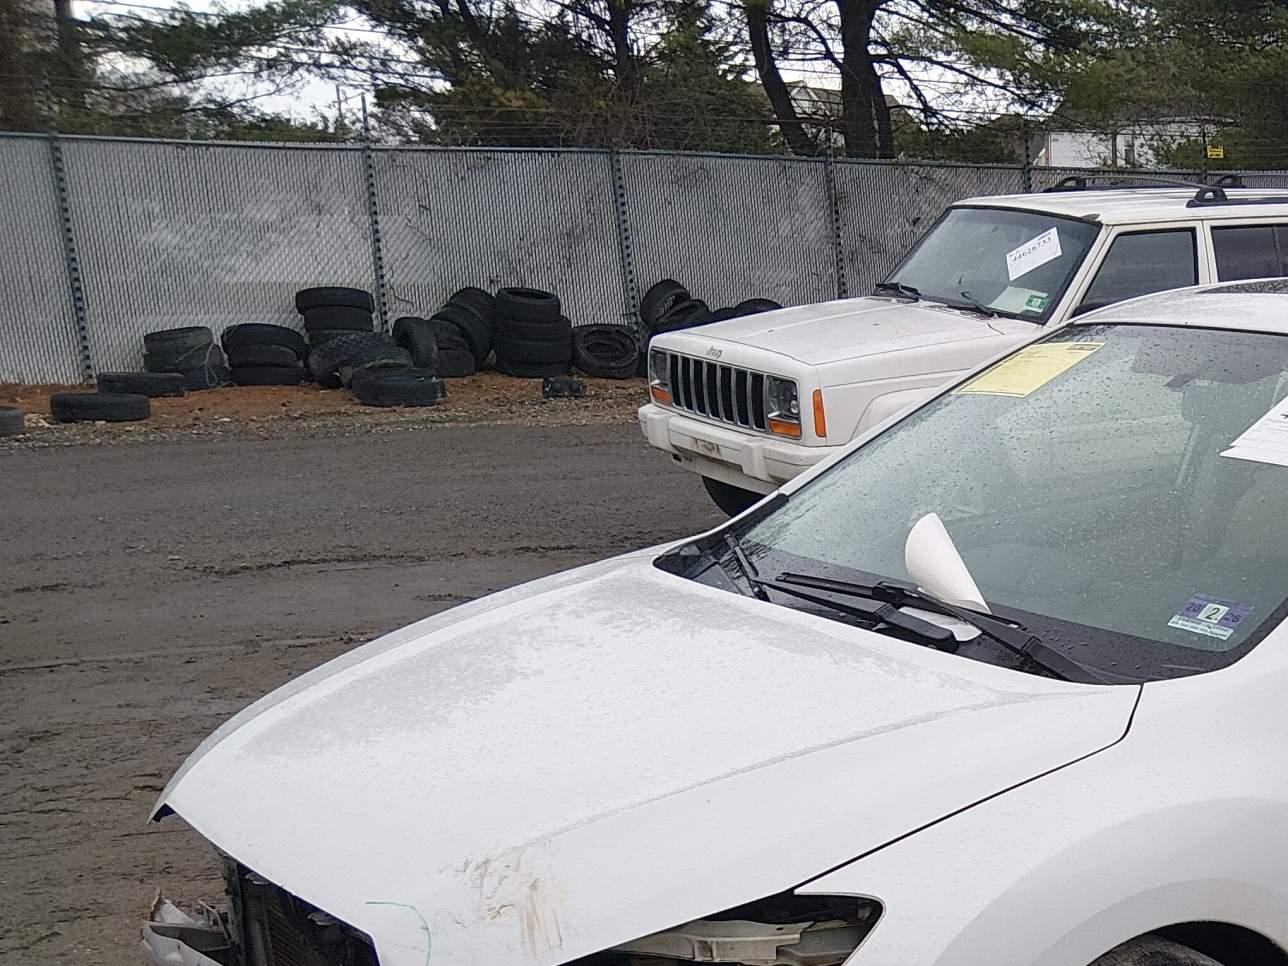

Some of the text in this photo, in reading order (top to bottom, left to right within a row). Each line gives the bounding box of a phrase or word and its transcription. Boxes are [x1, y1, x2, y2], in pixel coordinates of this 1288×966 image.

[1185, 602, 1243, 623] 20 2 26
